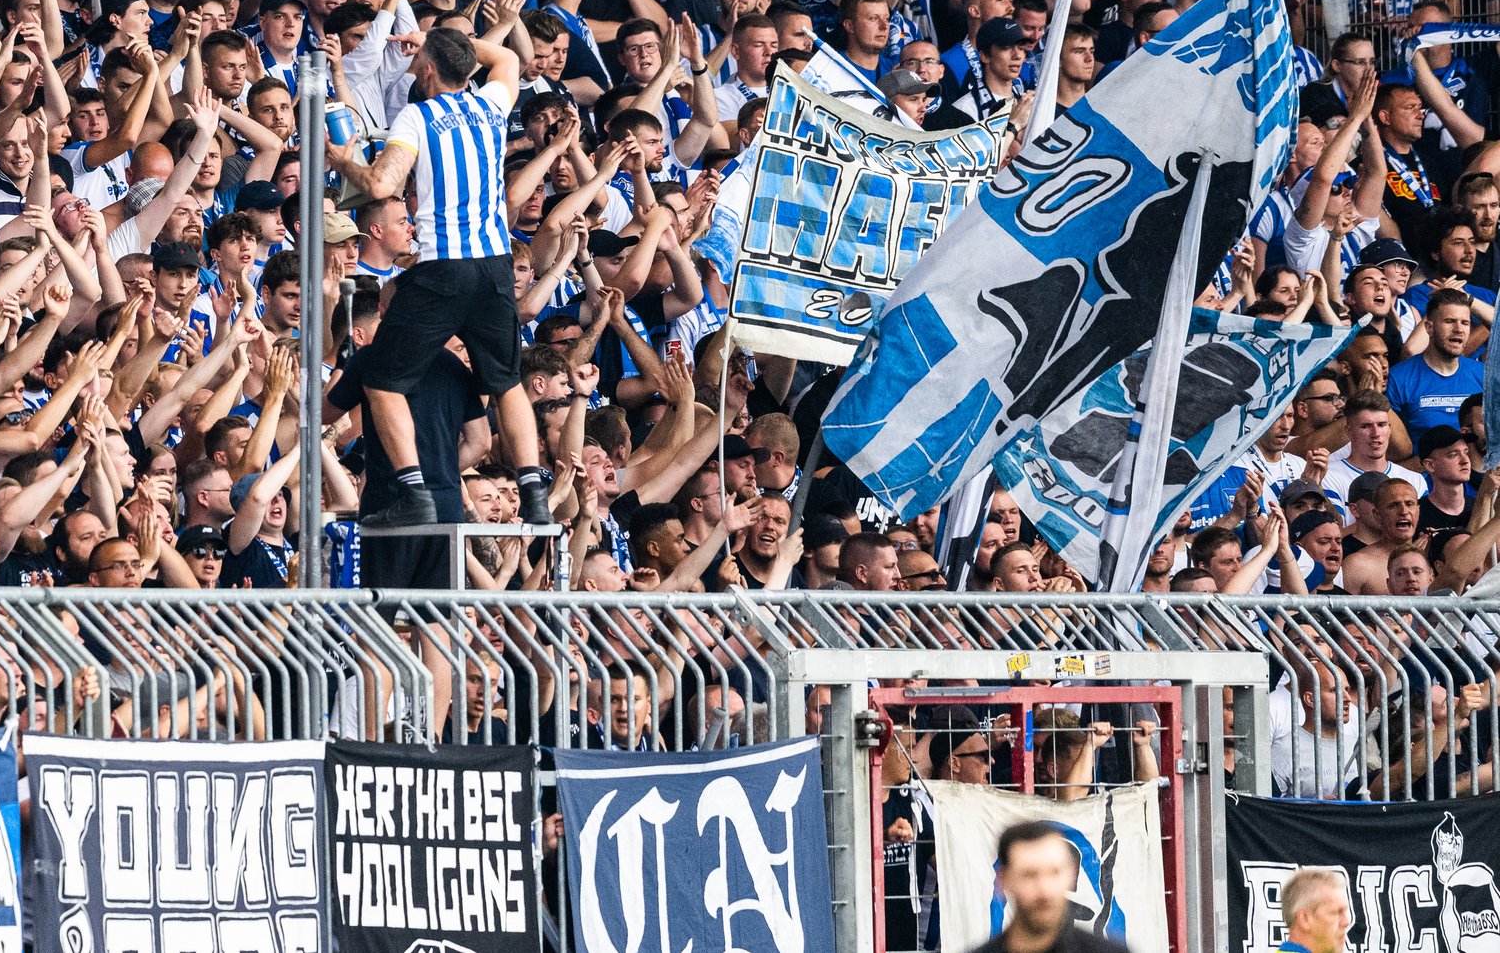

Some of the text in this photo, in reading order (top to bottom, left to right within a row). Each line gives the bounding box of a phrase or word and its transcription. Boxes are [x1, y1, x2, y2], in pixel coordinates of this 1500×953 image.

[430, 111, 484, 136] HERTHA
[744, 148, 995, 282] MAF
[334, 764, 522, 842] HERTHA BSC
[335, 841, 526, 934] HOOLIGANS
